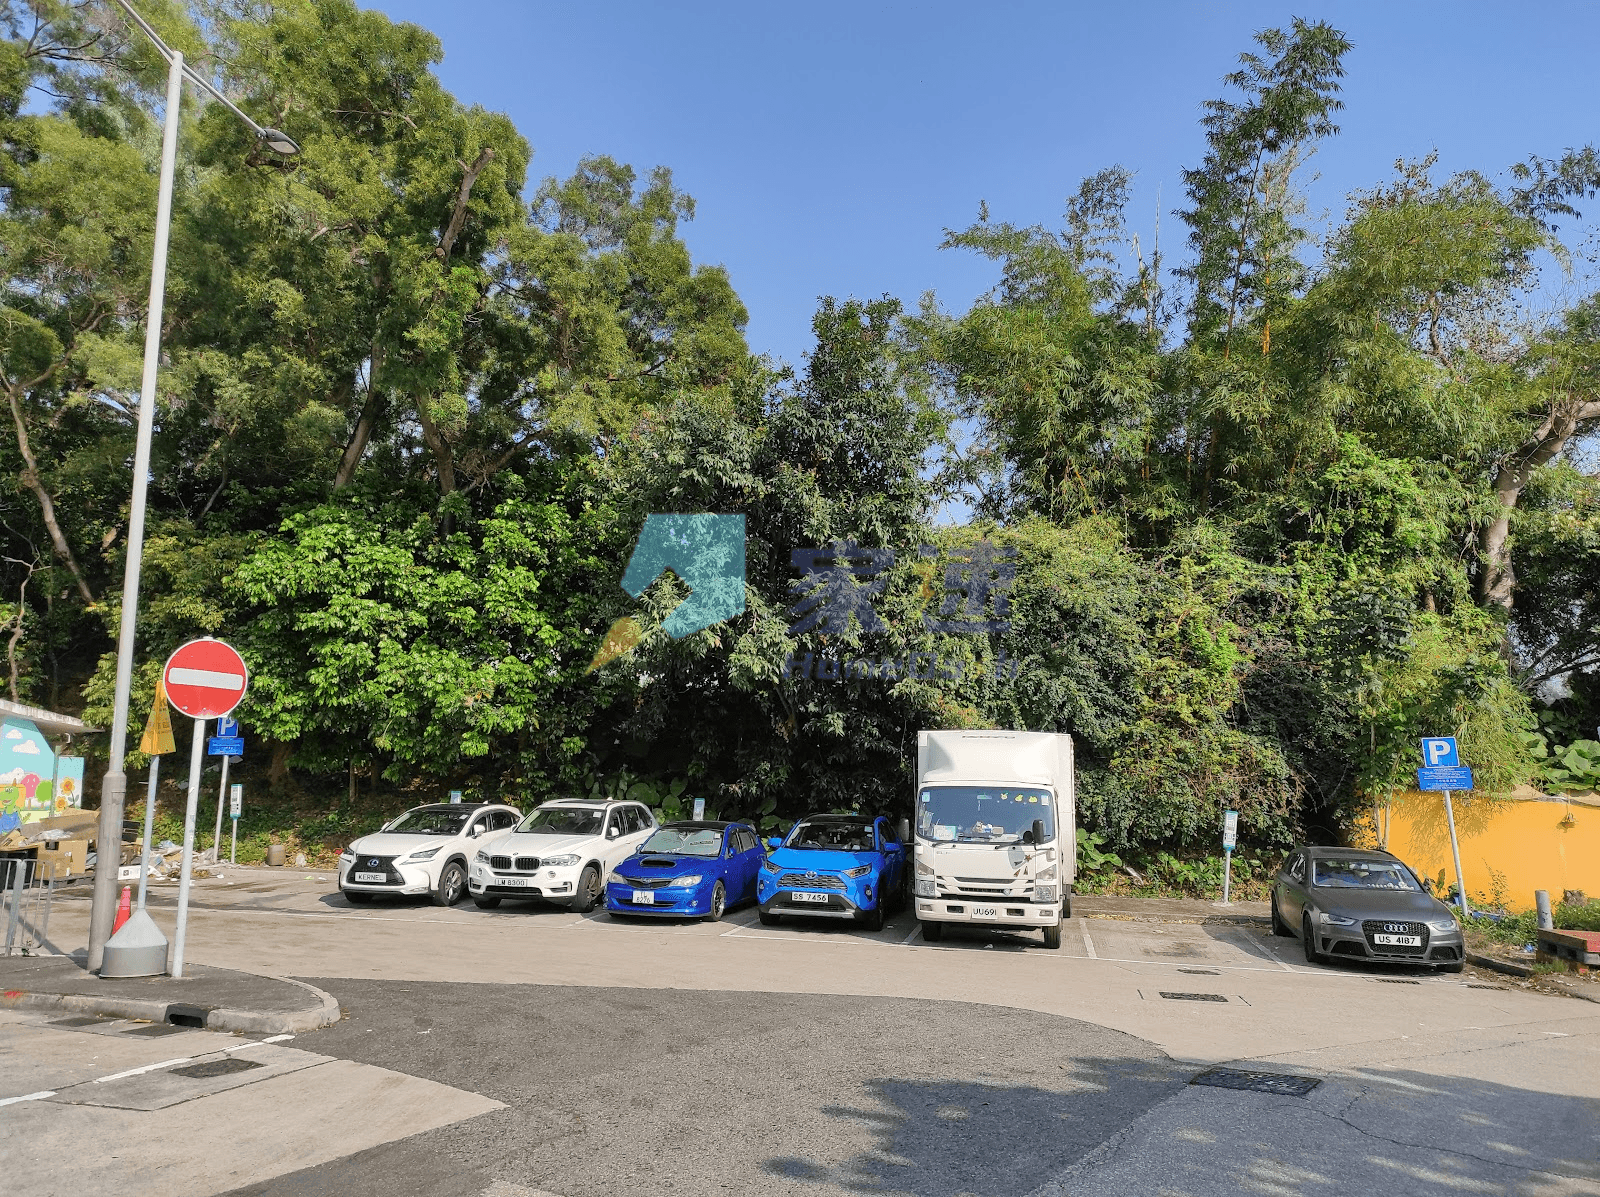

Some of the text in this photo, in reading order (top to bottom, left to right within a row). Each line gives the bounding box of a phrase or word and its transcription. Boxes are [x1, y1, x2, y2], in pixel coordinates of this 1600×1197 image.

[1428, 740, 1451, 765] P
[358, 873, 384, 881] KERNEL
[806, 893, 827, 902] 7456
[972, 908, 997, 916] UU691
[1378, 935, 1416, 945] US 4187
